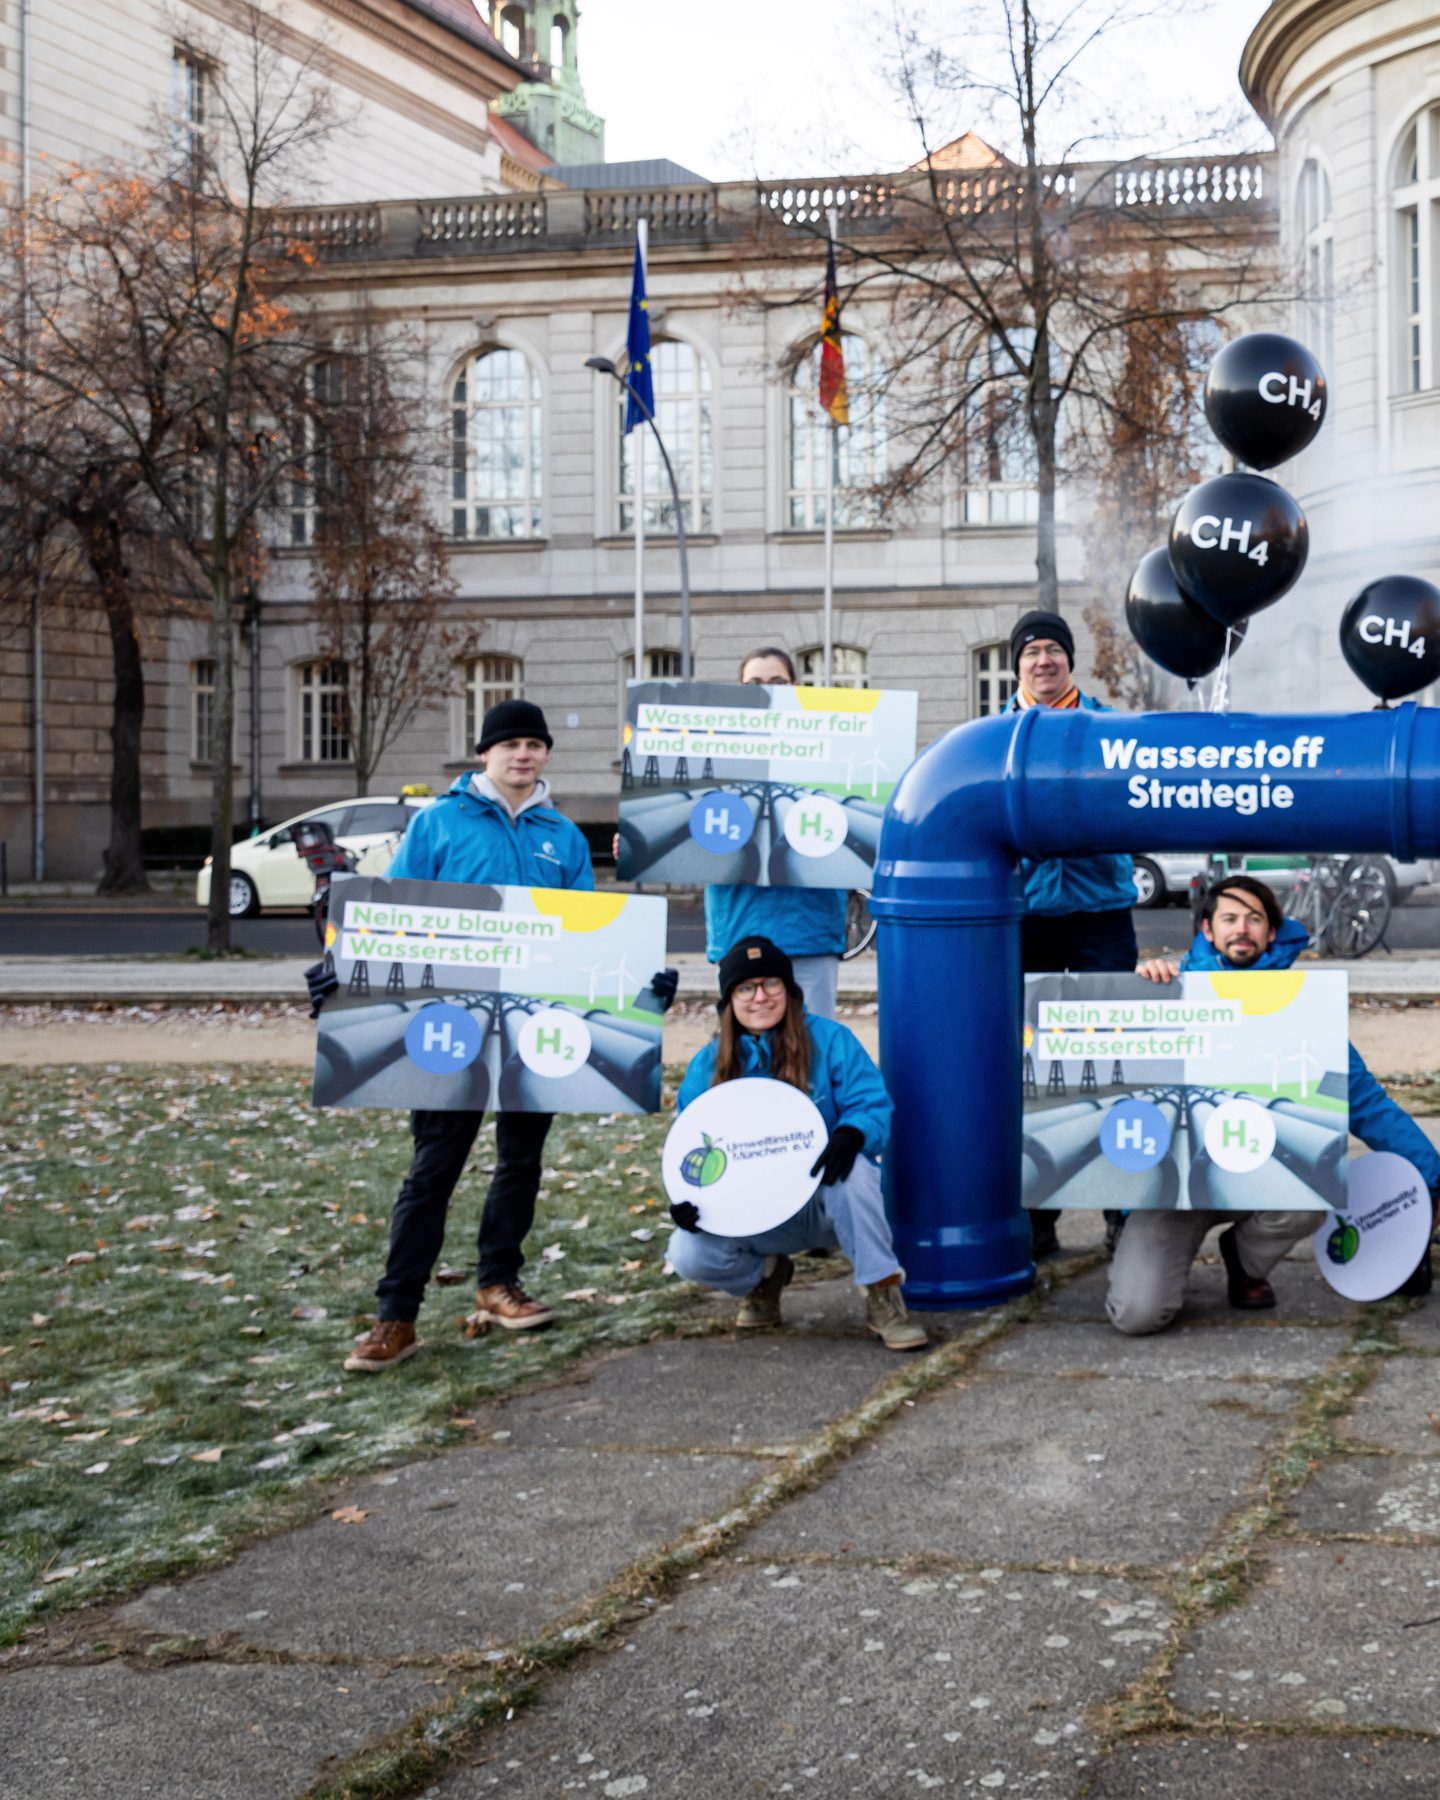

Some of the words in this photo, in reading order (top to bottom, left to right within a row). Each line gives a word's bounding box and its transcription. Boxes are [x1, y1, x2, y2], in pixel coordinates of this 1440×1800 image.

[1258, 371, 1322, 421] CH4
[1190, 515, 1270, 566] CH4
[1359, 615, 1426, 659] CH4
[644, 708, 781, 730] Wasserstoff
[787, 716, 823, 731] nur
[829, 714, 867, 733] fair
[643, 737, 685, 753] und
[692, 739, 825, 758] erneuerbar!
[1100, 735, 1325, 770] Wasserstoff
[1128, 774, 1294, 815] Strategie
[704, 808, 740, 840] H2
[799, 812, 833, 842] H2
[352, 905, 413, 929] Nein
[421, 912, 450, 930] zu
[458, 911, 554, 937] blauem
[350, 936, 523, 964] Wasserstoff!
[1046, 1005, 1102, 1024] Nein
[1108, 1008, 1134, 1024] zu
[1142, 1003, 1235, 1024] blauem
[423, 1021, 465, 1059] H2
[536, 1027, 574, 1060] H2
[1045, 1035, 1205, 1056] Wasserstoff!
[726, 1129, 815, 1151] Umweltinstitut
[732, 1145, 788, 1161] München
[1116, 1119, 1156, 1155] H2
[1222, 1120, 1260, 1154] H2
